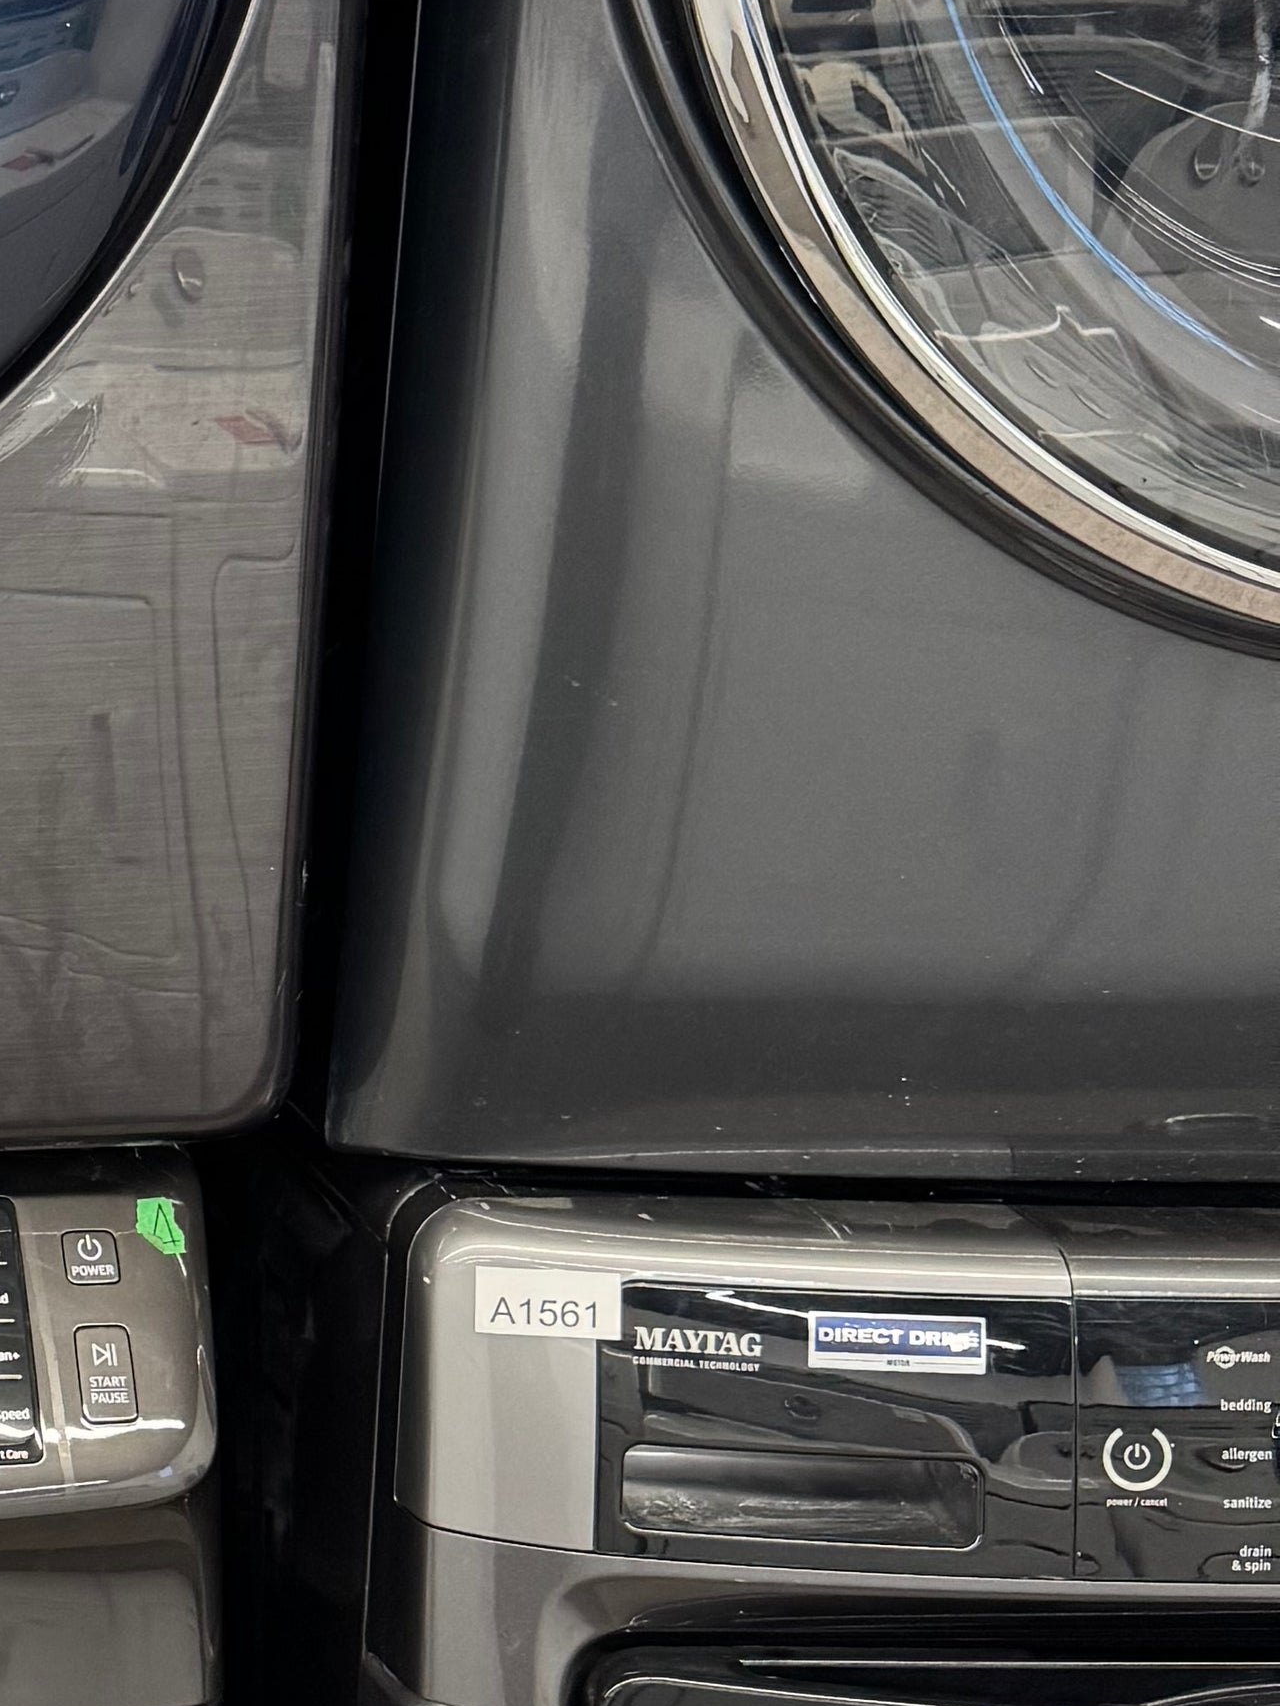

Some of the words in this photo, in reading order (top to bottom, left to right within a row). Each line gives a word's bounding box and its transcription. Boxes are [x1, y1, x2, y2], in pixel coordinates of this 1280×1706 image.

[72, 1265, 114, 1276] POWER
[491, 1297, 597, 1328] A1561
[634, 1326, 762, 1357] MAYTAG
[818, 1327, 904, 1344] DIRECT
[633, 1356, 694, 1368] COMMERCIAL
[699, 1361, 760, 1372] TECHNOLOGY
[90, 1377, 127, 1387] START
[90, 1392, 129, 1403] PAUSE
[1221, 1399, 1272, 1414] bedding
[1222, 1449, 1272, 1462] allergen
[1106, 1498, 1133, 1507] power
[1140, 1498, 1167, 1506] cancel
[1224, 1497, 1272, 1509] sanitize
[1240, 1545, 1272, 1557] drain
[1232, 1560, 1241, 1571] &
[1246, 1559, 1271, 1575] spin
